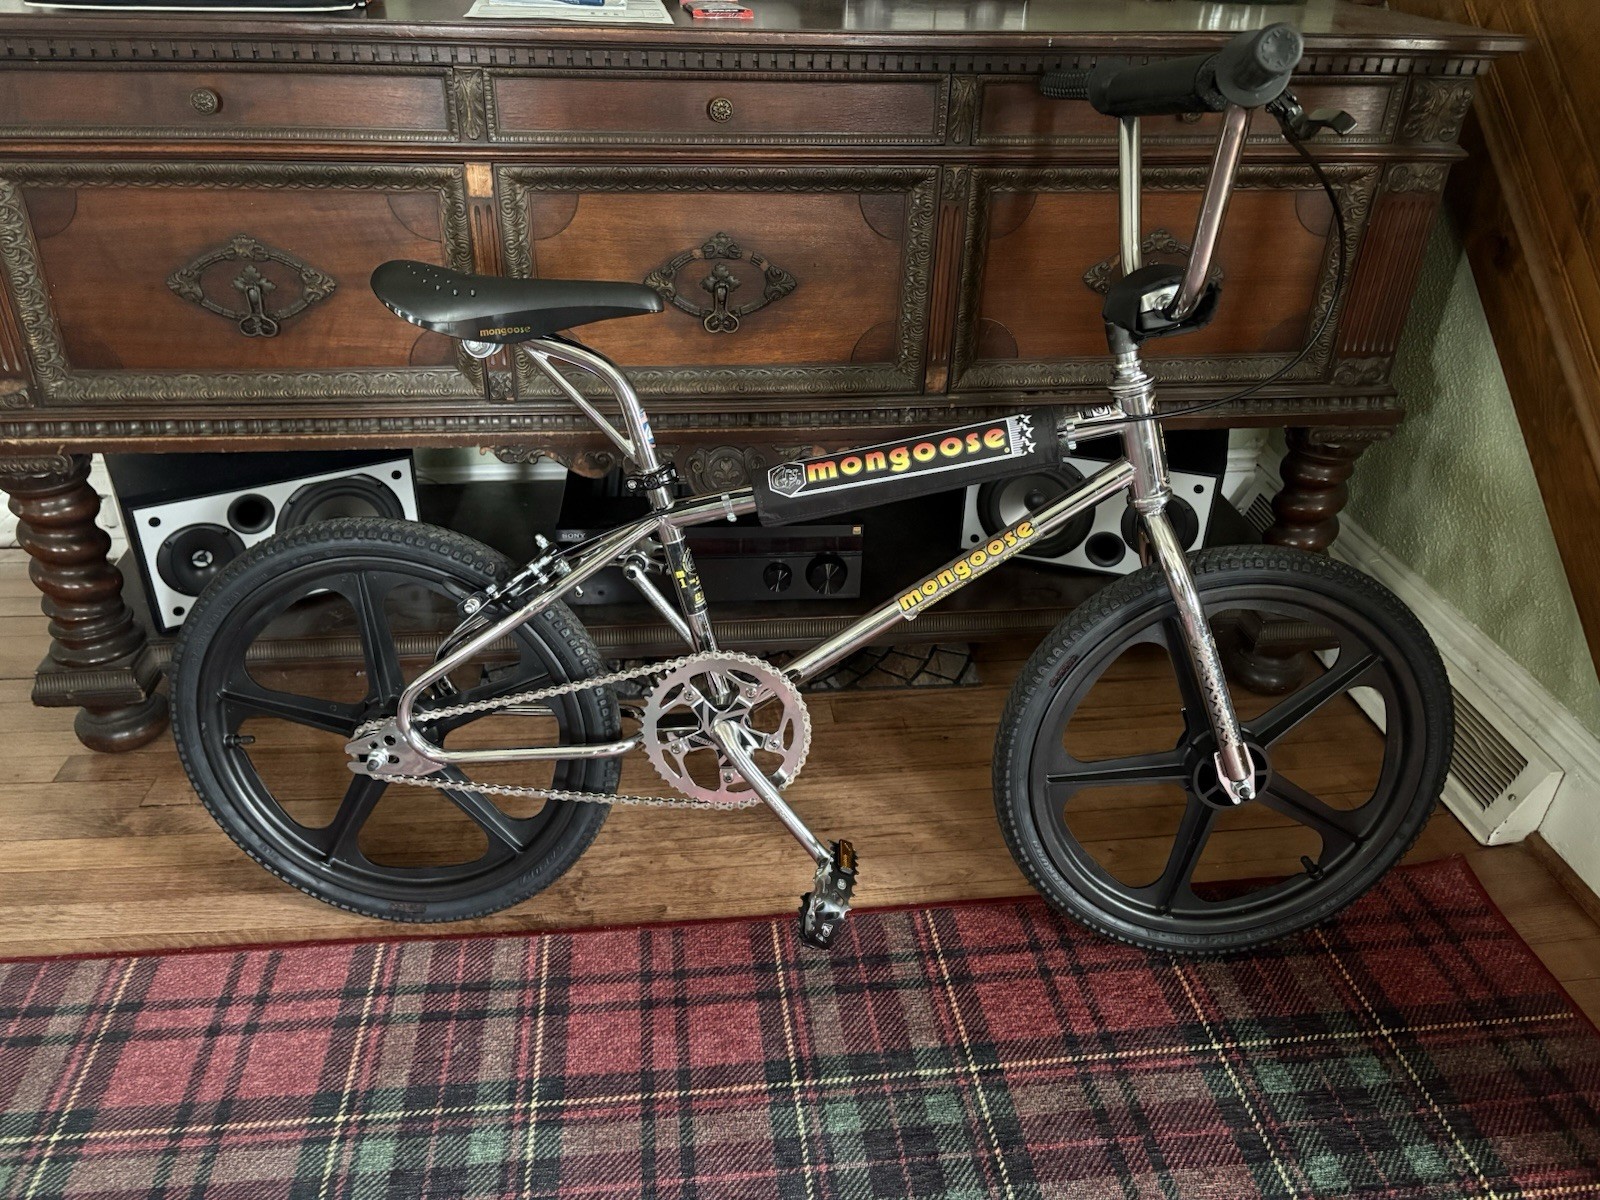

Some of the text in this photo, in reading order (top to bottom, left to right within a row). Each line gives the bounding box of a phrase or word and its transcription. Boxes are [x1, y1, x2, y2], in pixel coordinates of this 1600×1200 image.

[479, 326, 531, 337] mongoose
[806, 427, 1007, 483] mongoose
[898, 520, 1036, 611] mongoose
